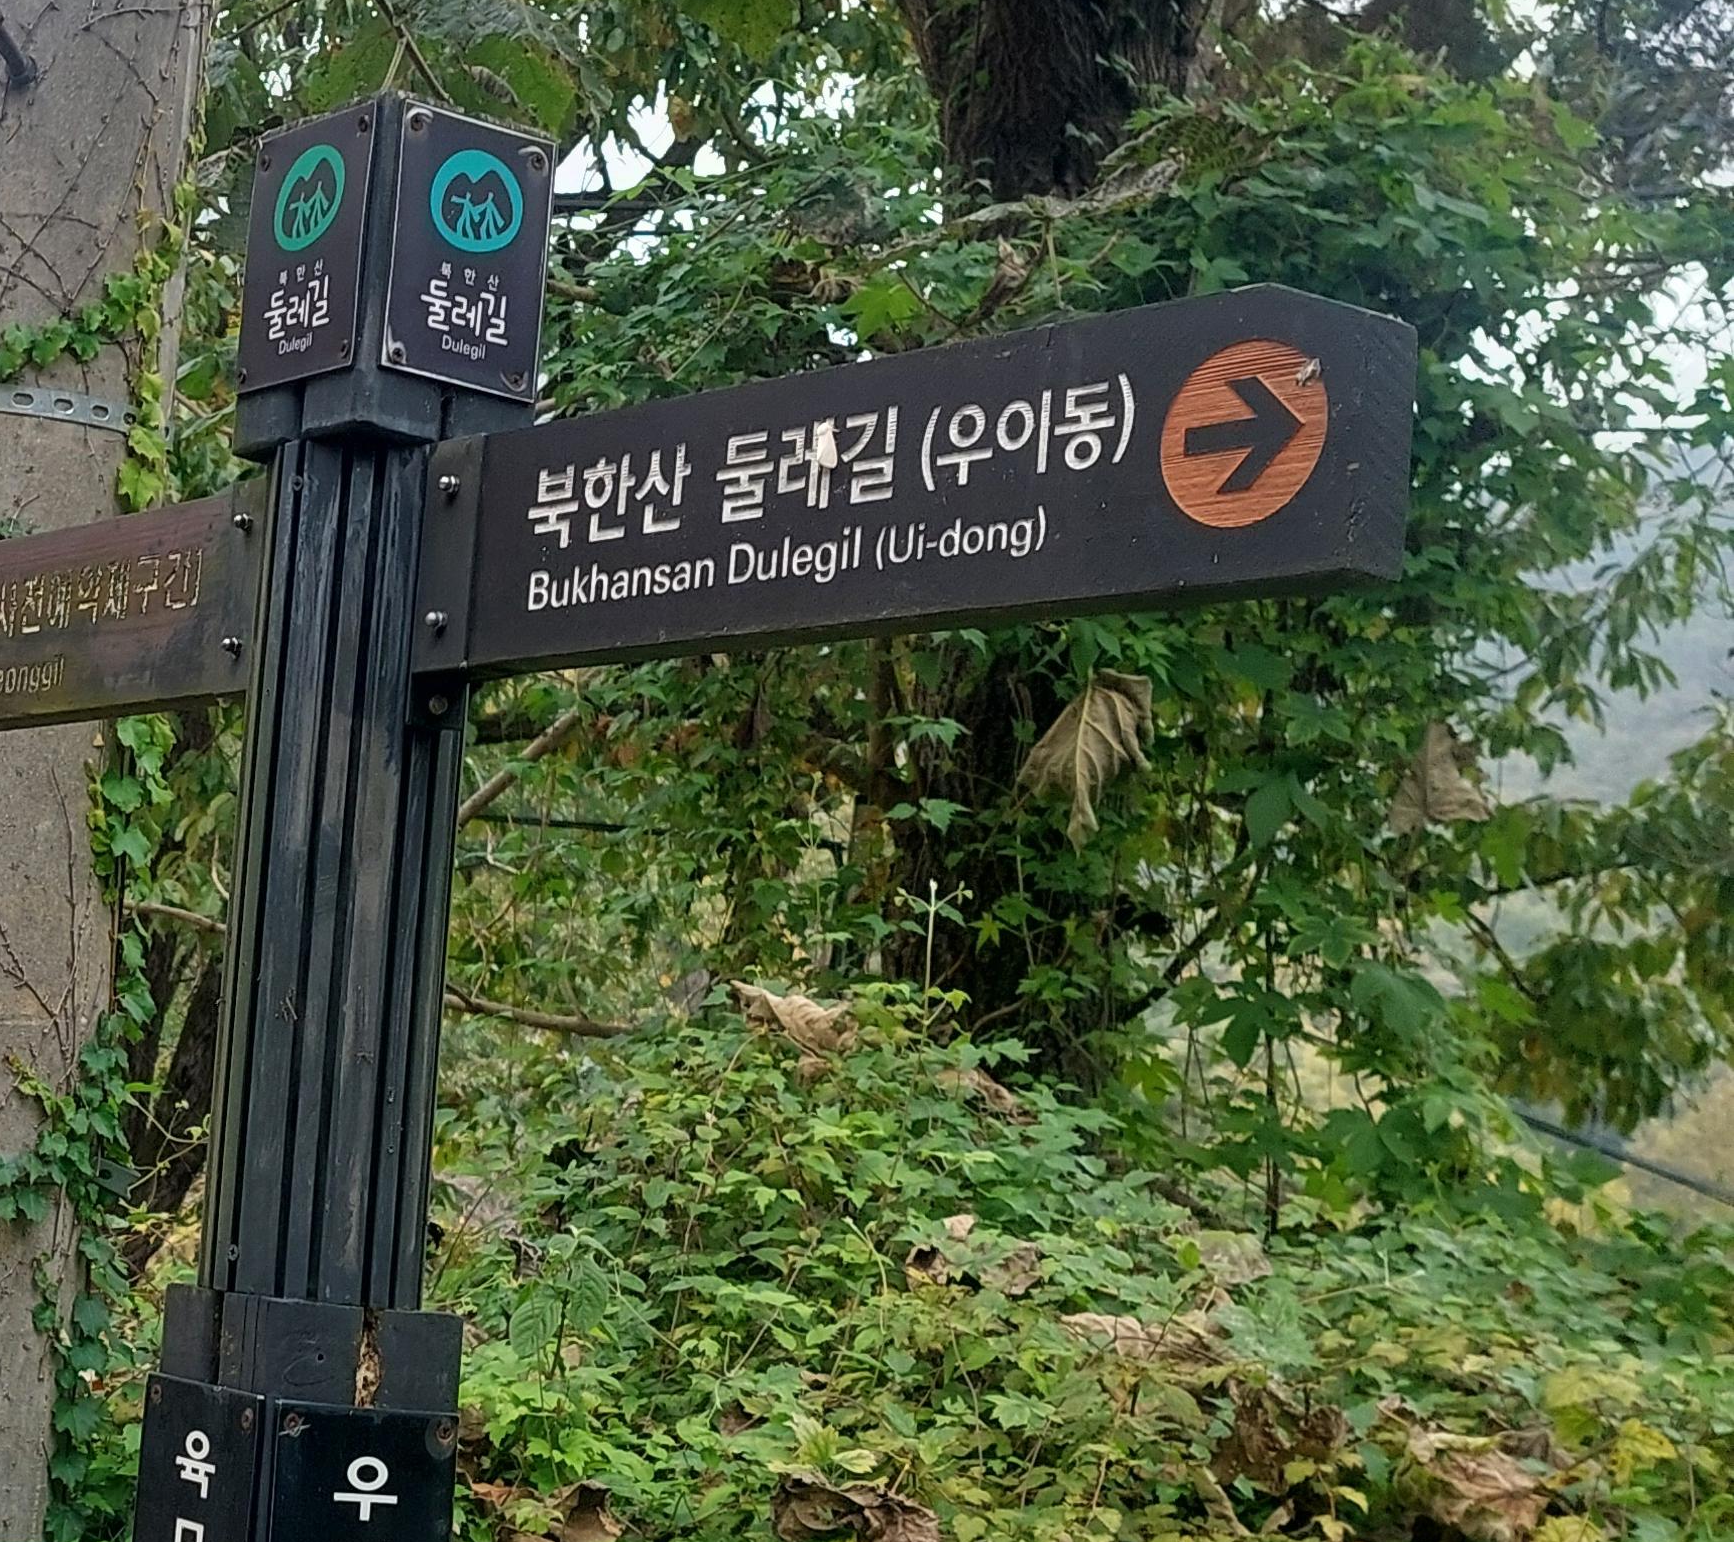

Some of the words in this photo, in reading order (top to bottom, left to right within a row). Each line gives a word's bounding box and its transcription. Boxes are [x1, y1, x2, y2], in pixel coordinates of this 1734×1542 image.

[263, 274, 330, 341] 둘레길
[420, 278, 509, 347] 둘레길
[277, 331, 314, 356] Dulegil
[441, 334, 487, 360] Dulegil
[526, 441, 692, 549] 북한산
[715, 405, 899, 524] 둘레길
[921, 373, 1136, 493] (우이동)
[526, 556, 715, 612] Bukhansan
[727, 525, 863, 585] Dulegil
[875, 505, 1049, 571] (Ui-dong)
